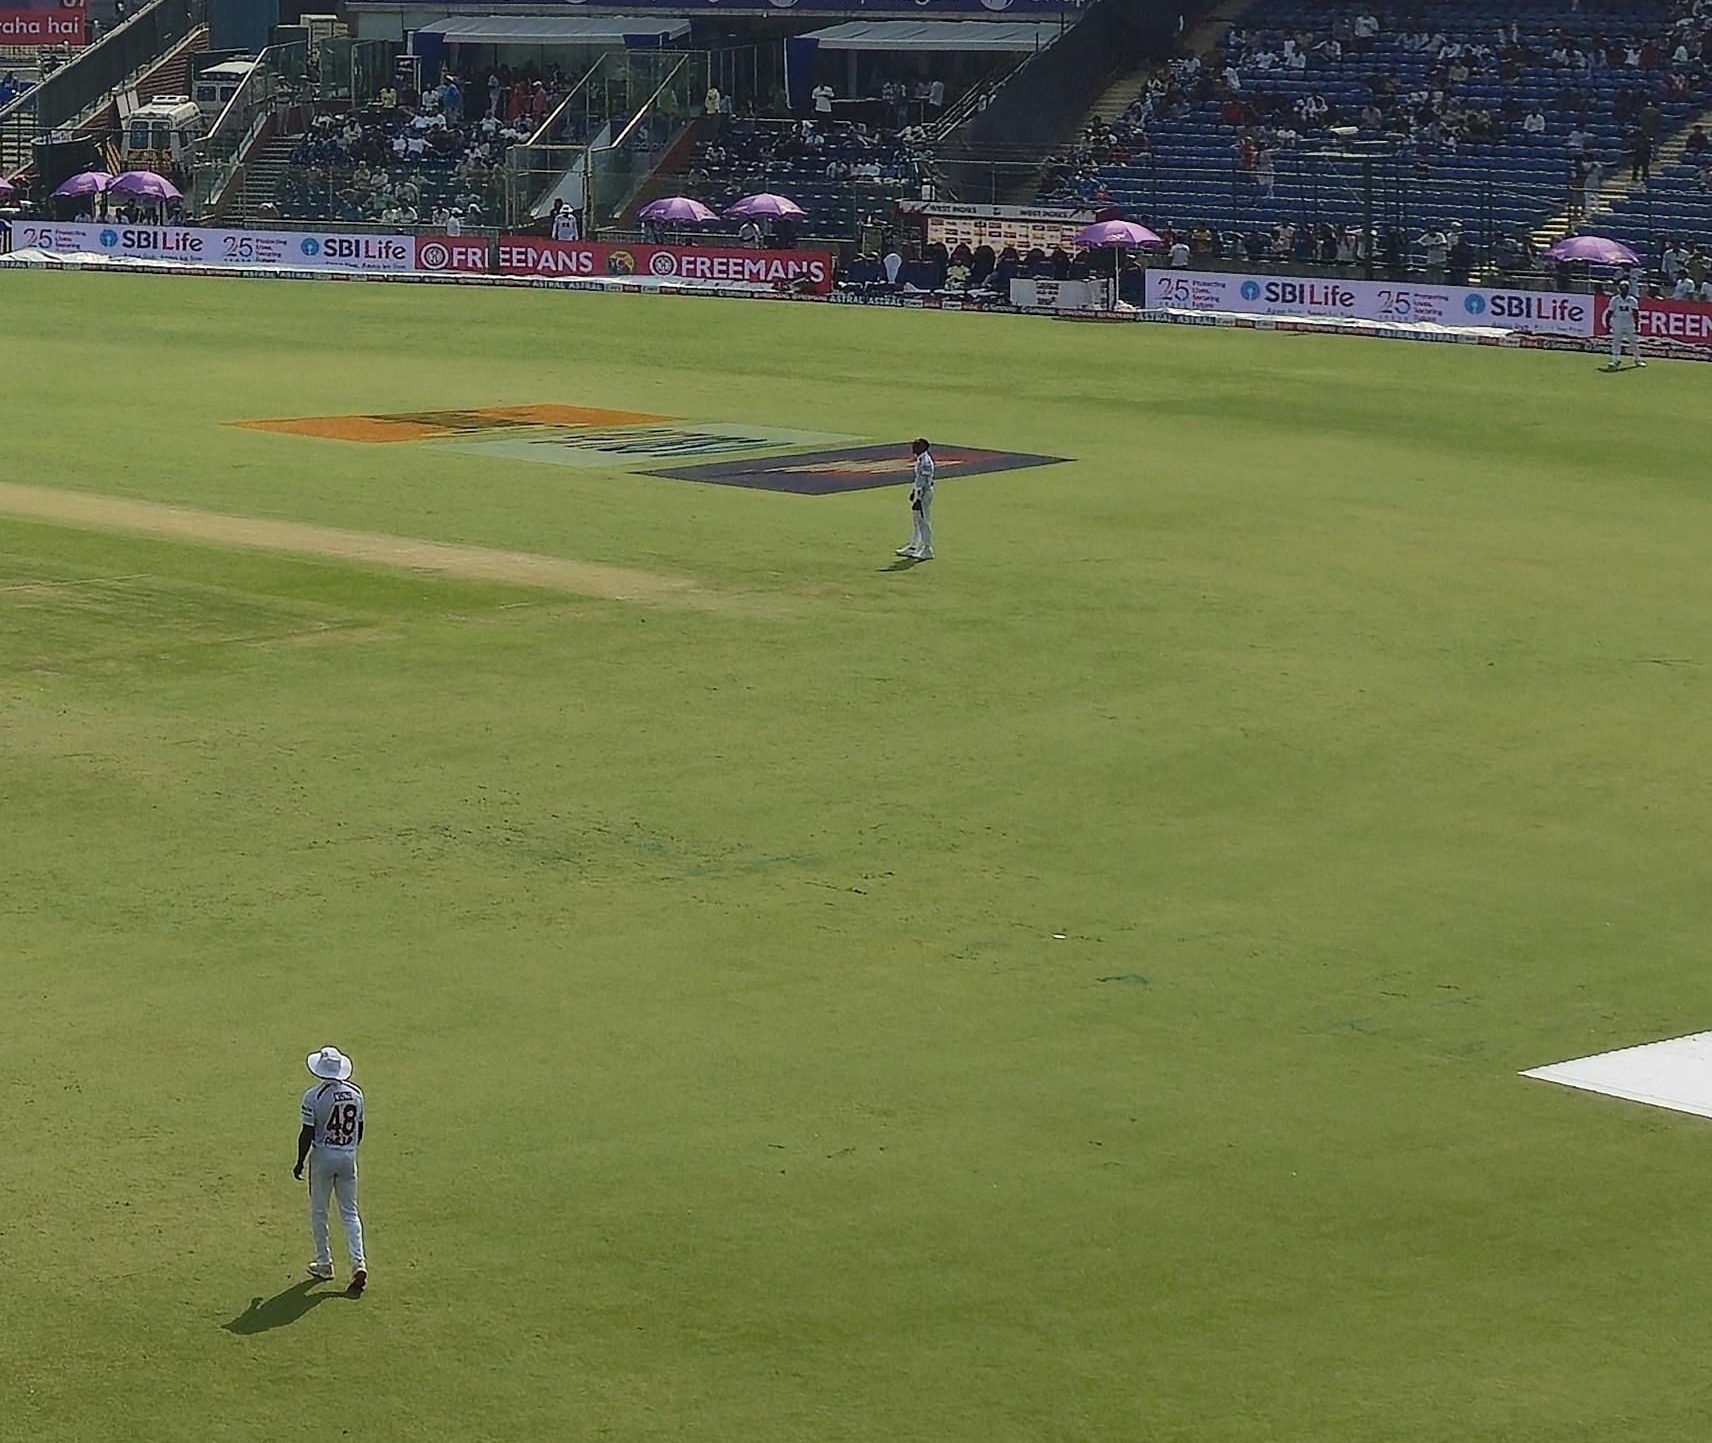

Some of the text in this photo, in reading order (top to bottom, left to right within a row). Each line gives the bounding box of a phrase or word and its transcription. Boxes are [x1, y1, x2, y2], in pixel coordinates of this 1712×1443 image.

[48, 16, 79, 35] hai
[122, 229, 158, 250] SBI
[162, 231, 203, 252] Life
[323, 238, 361, 258] SBI
[365, 239, 407, 260] Life
[681, 256, 824, 284] FREEMANS
[1158, 278, 1190, 301] 25
[1265, 282, 1304, 305] SBI
[1308, 284, 1355, 308] Life
[1491, 296, 1531, 317] SBI
[1537, 298, 1584, 322] Life
[1638, 310, 1712, 338] FREE
[326, 1103, 357, 1137] 48
